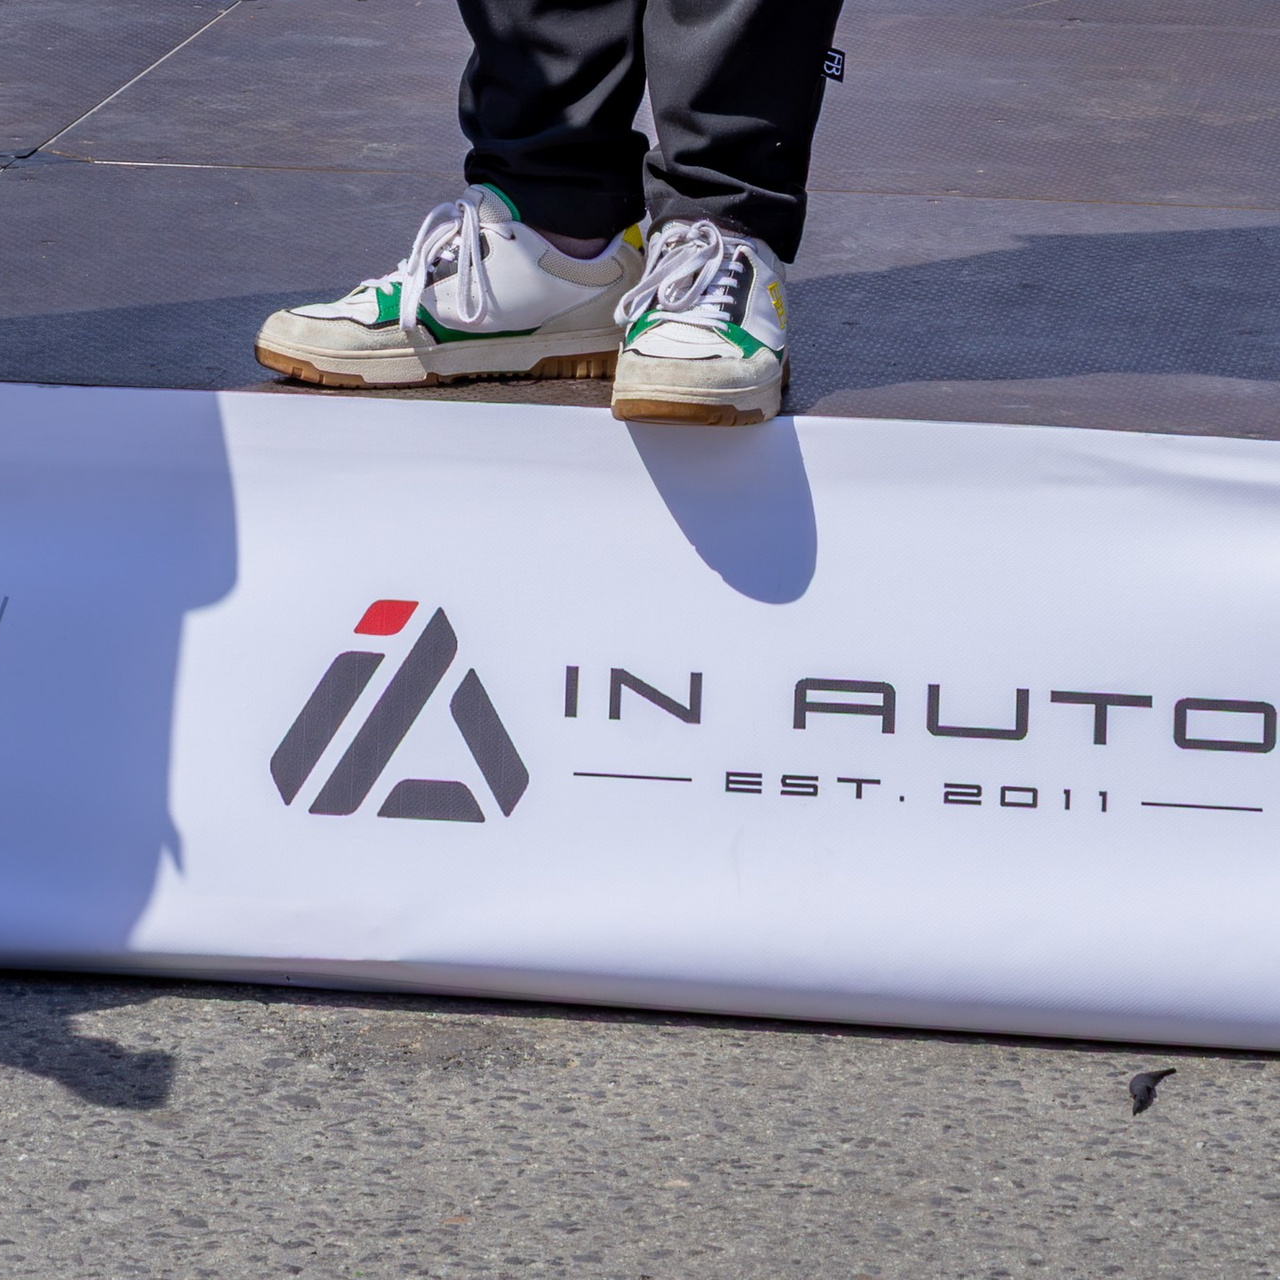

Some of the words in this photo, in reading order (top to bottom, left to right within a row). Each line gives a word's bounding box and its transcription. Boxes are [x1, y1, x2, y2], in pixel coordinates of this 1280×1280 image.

[564, 665, 703, 725] IN
[792, 677, 1278, 754] AUTO
[724, 771, 905, 803] EST.
[943, 782, 1108, 813] 2011
